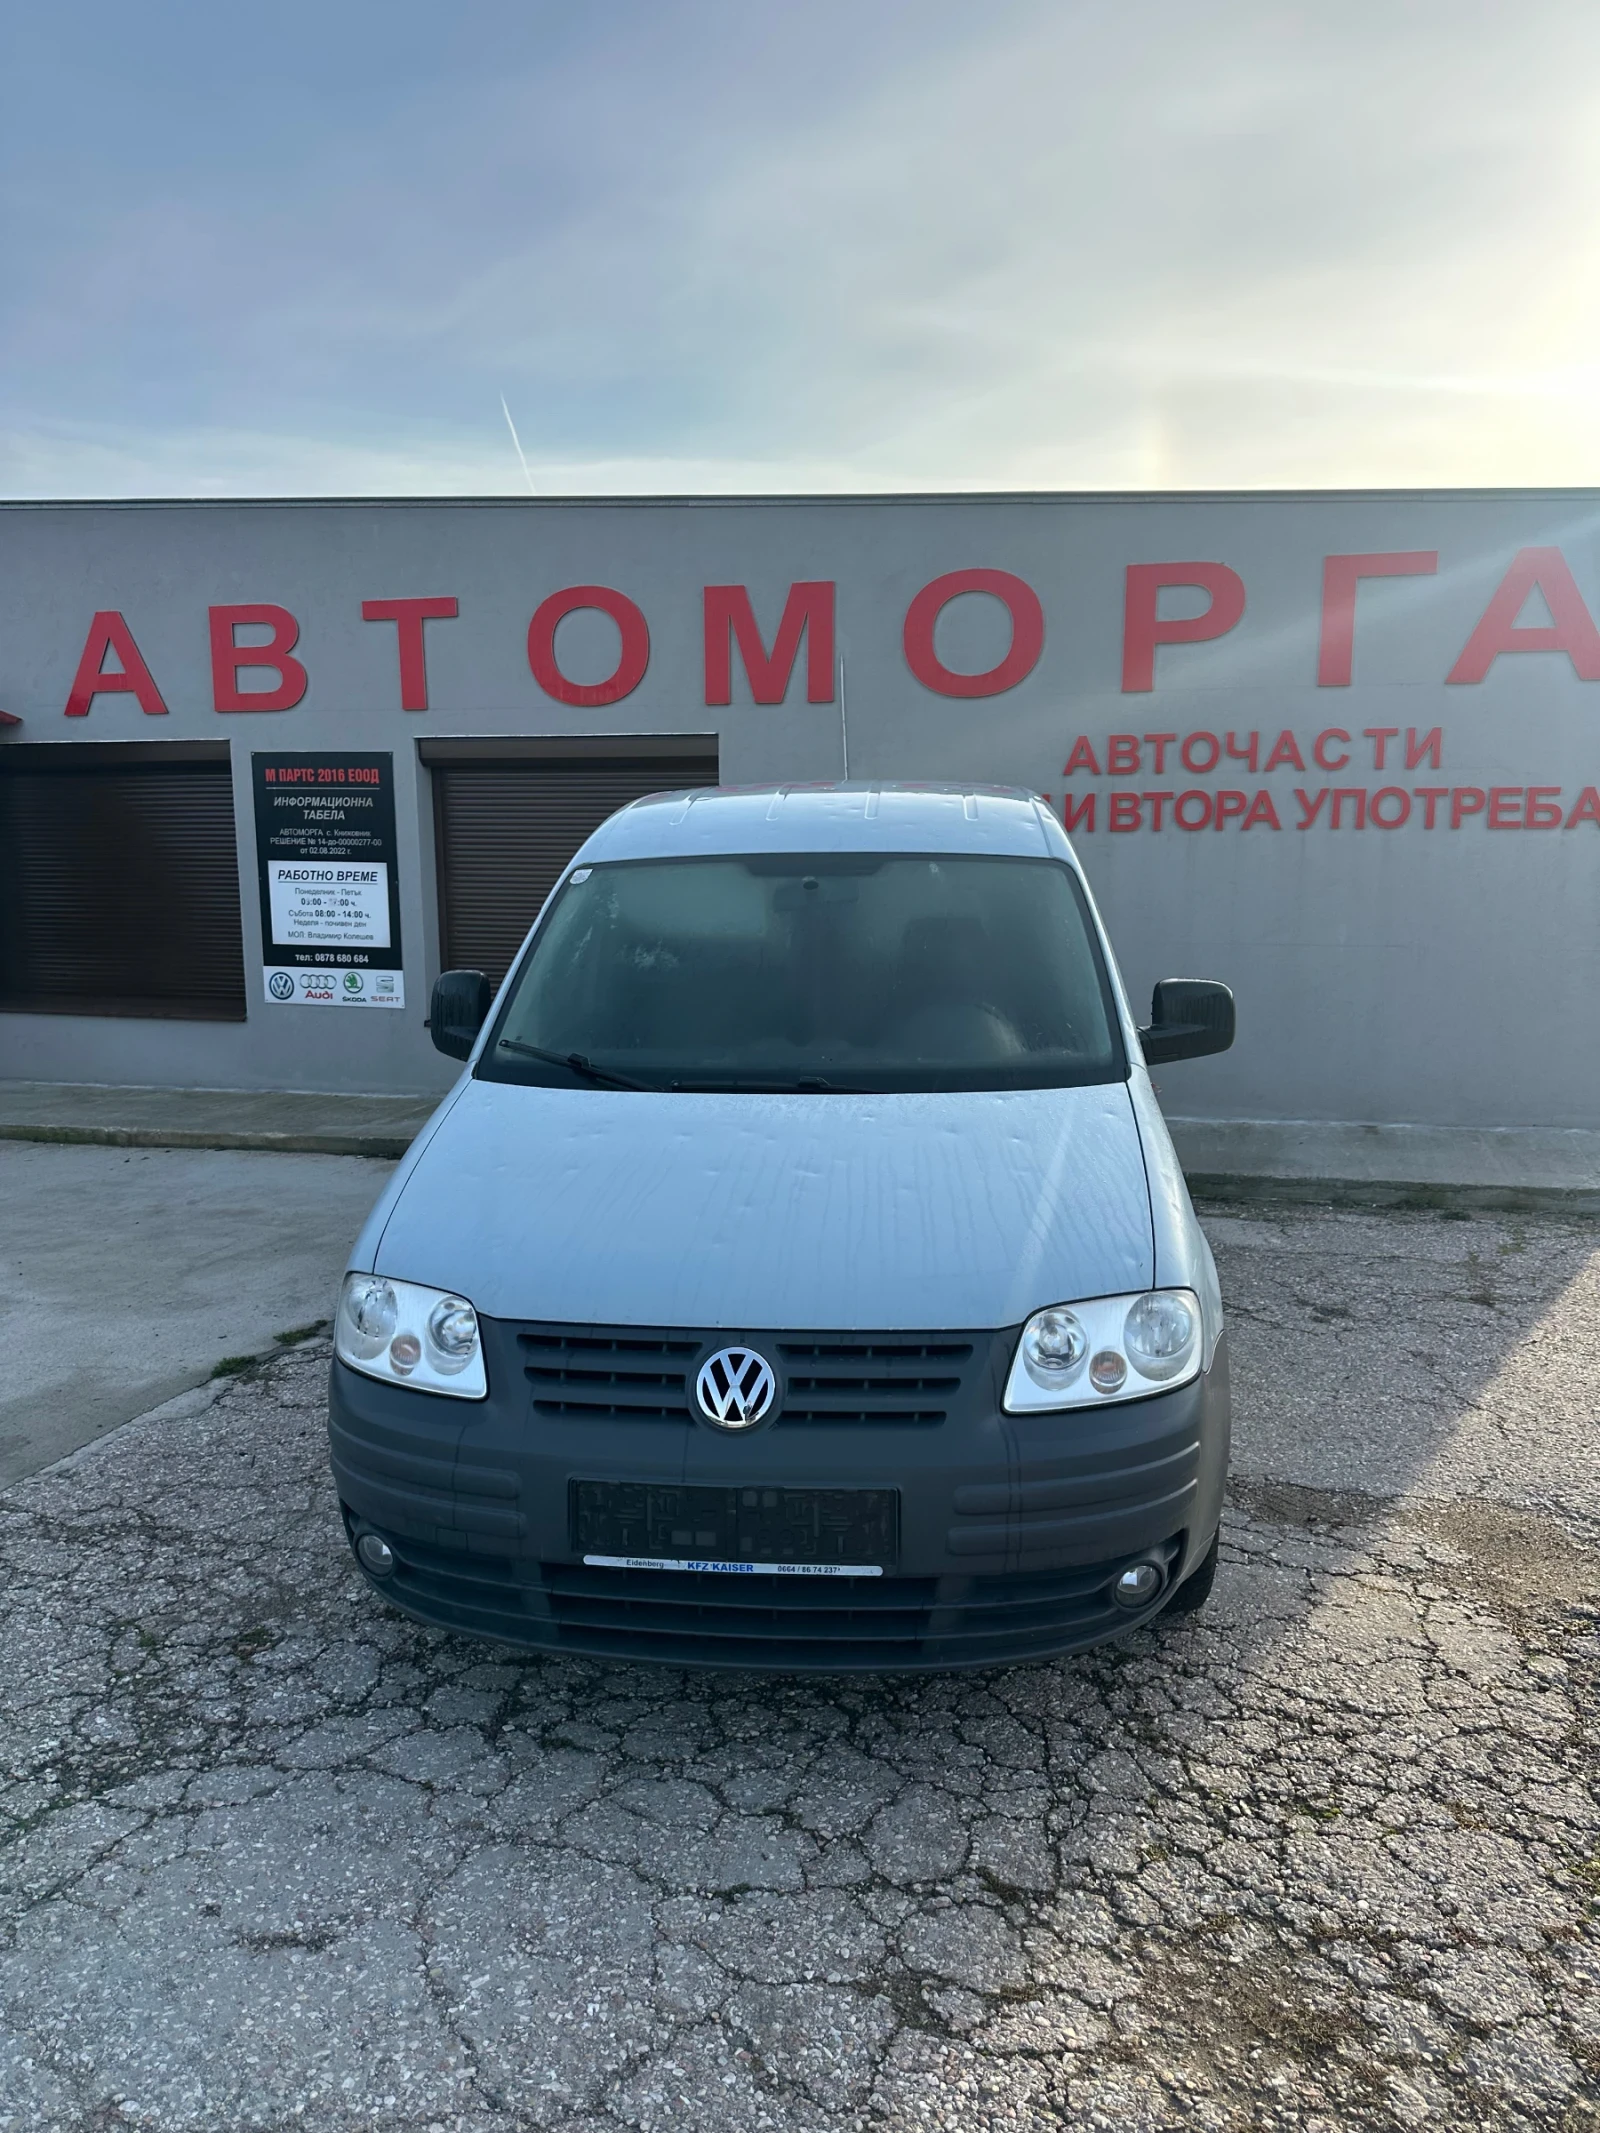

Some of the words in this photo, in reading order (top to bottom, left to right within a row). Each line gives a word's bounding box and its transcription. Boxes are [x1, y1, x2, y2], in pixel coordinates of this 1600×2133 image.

[64, 546, 1600, 717] АВТОМОРГА
[1063, 727, 1443, 776] АВТОЧАСТИ
[265, 768, 276, 782] М
[279, 768, 315, 782] ПАРТС
[318, 768, 345, 782] 2016
[348, 768, 380, 784] ЕООД
[273, 797, 374, 809] ИНФОРМАЦИОННА
[1064, 793, 1096, 832] И
[1109, 788, 1281, 832] ВТОРА
[1296, 785, 1600, 831] УПОТРЕБА
[303, 810, 346, 820] ТАБЕЛА
[279, 828, 324, 837] АВТОМОРГА
[270, 837, 306, 846] РЕШЕНИЕ
[278, 869, 333, 881] РАБОТНО
[336, 871, 378, 882] ВРЕМЕ
[314, 910, 336, 918] 08:00
[342, 910, 363, 919] 14:00
[295, 954, 313, 962] тел:
[315, 953, 335, 962] 0878
[336, 954, 352, 963] 680
[353, 954, 369, 963] 684
[305, 990, 333, 999] Audi
[626, 1559, 665, 1569] Eidenberg
[687, 1561, 709, 1571] KFZ
[712, 1562, 754, 1572] KAISER
